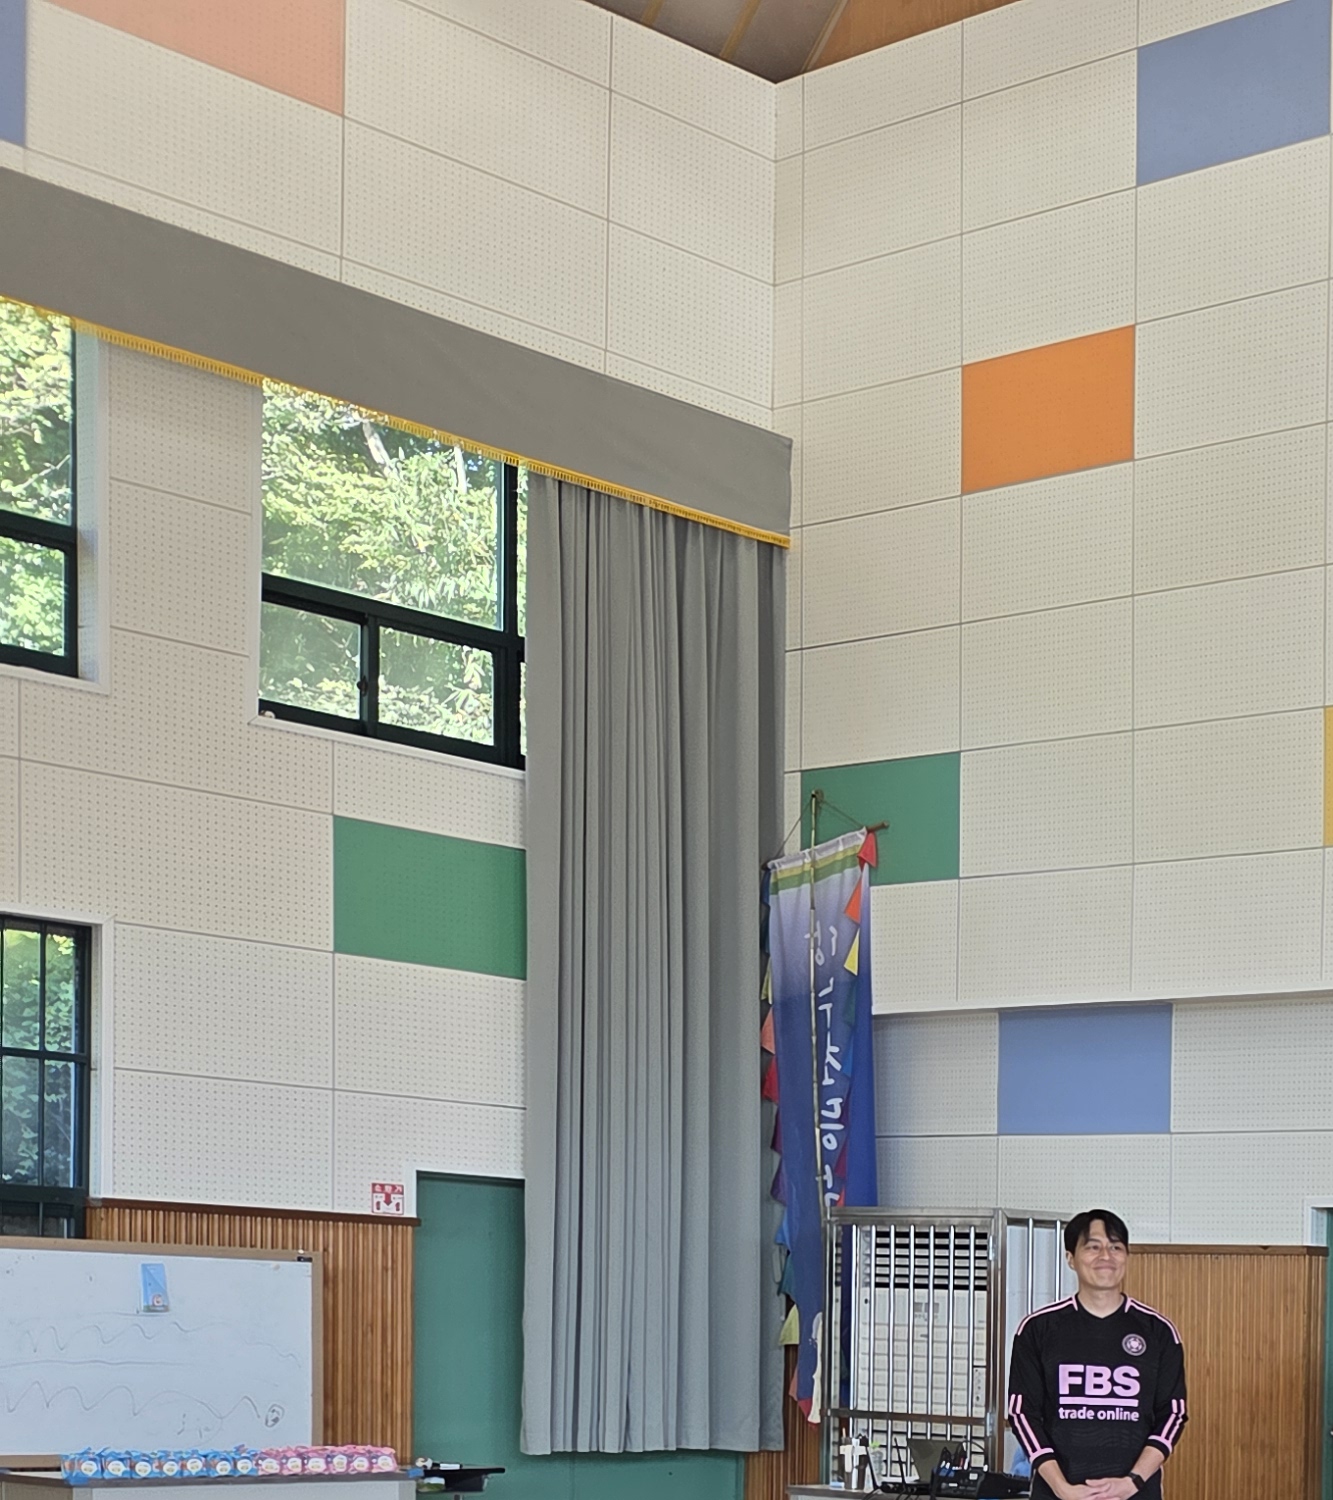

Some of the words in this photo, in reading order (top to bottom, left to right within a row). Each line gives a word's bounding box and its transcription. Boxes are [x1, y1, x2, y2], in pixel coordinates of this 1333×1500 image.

[1058, 1364, 1141, 1397] FBS
[1058, 1406, 1095, 1420] trade
[1097, 1407, 1140, 1422] online
